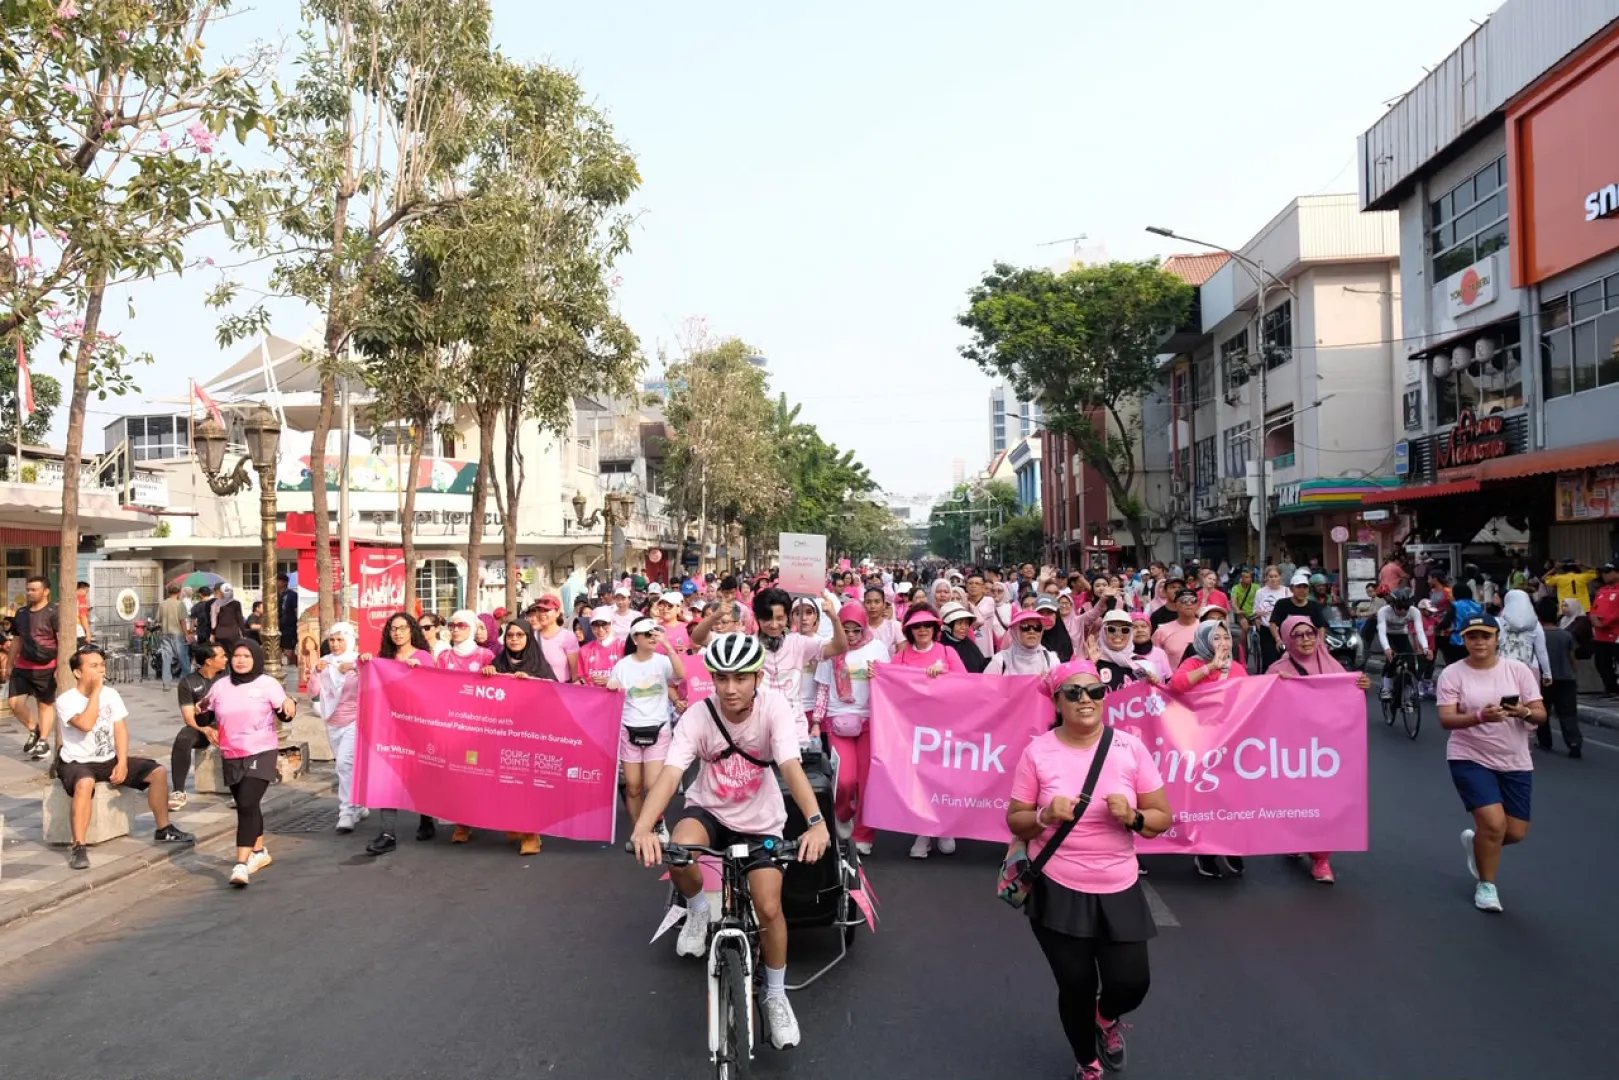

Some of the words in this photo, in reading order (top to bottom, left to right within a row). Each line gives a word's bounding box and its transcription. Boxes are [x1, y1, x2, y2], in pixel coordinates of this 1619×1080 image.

[1585, 183, 1619, 221] sn
[391, 711, 413, 721] Marriott
[414, 715, 453, 728] International
[484, 727, 507, 737] Hotels
[507, 729, 539, 740] Portfolio
[548, 734, 583, 747] Surabaya
[455, 711, 497, 724] collaboration
[912, 725, 1007, 774] Pink
[1233, 736, 1340, 780] Club
[931, 793, 939, 804] A
[942, 795, 961, 807] Fun
[964, 797, 991, 808] Walk
[1180, 811, 1214, 822] Breast
[1217, 809, 1255, 820] Cancer
[1259, 808, 1320, 819] Awareness
